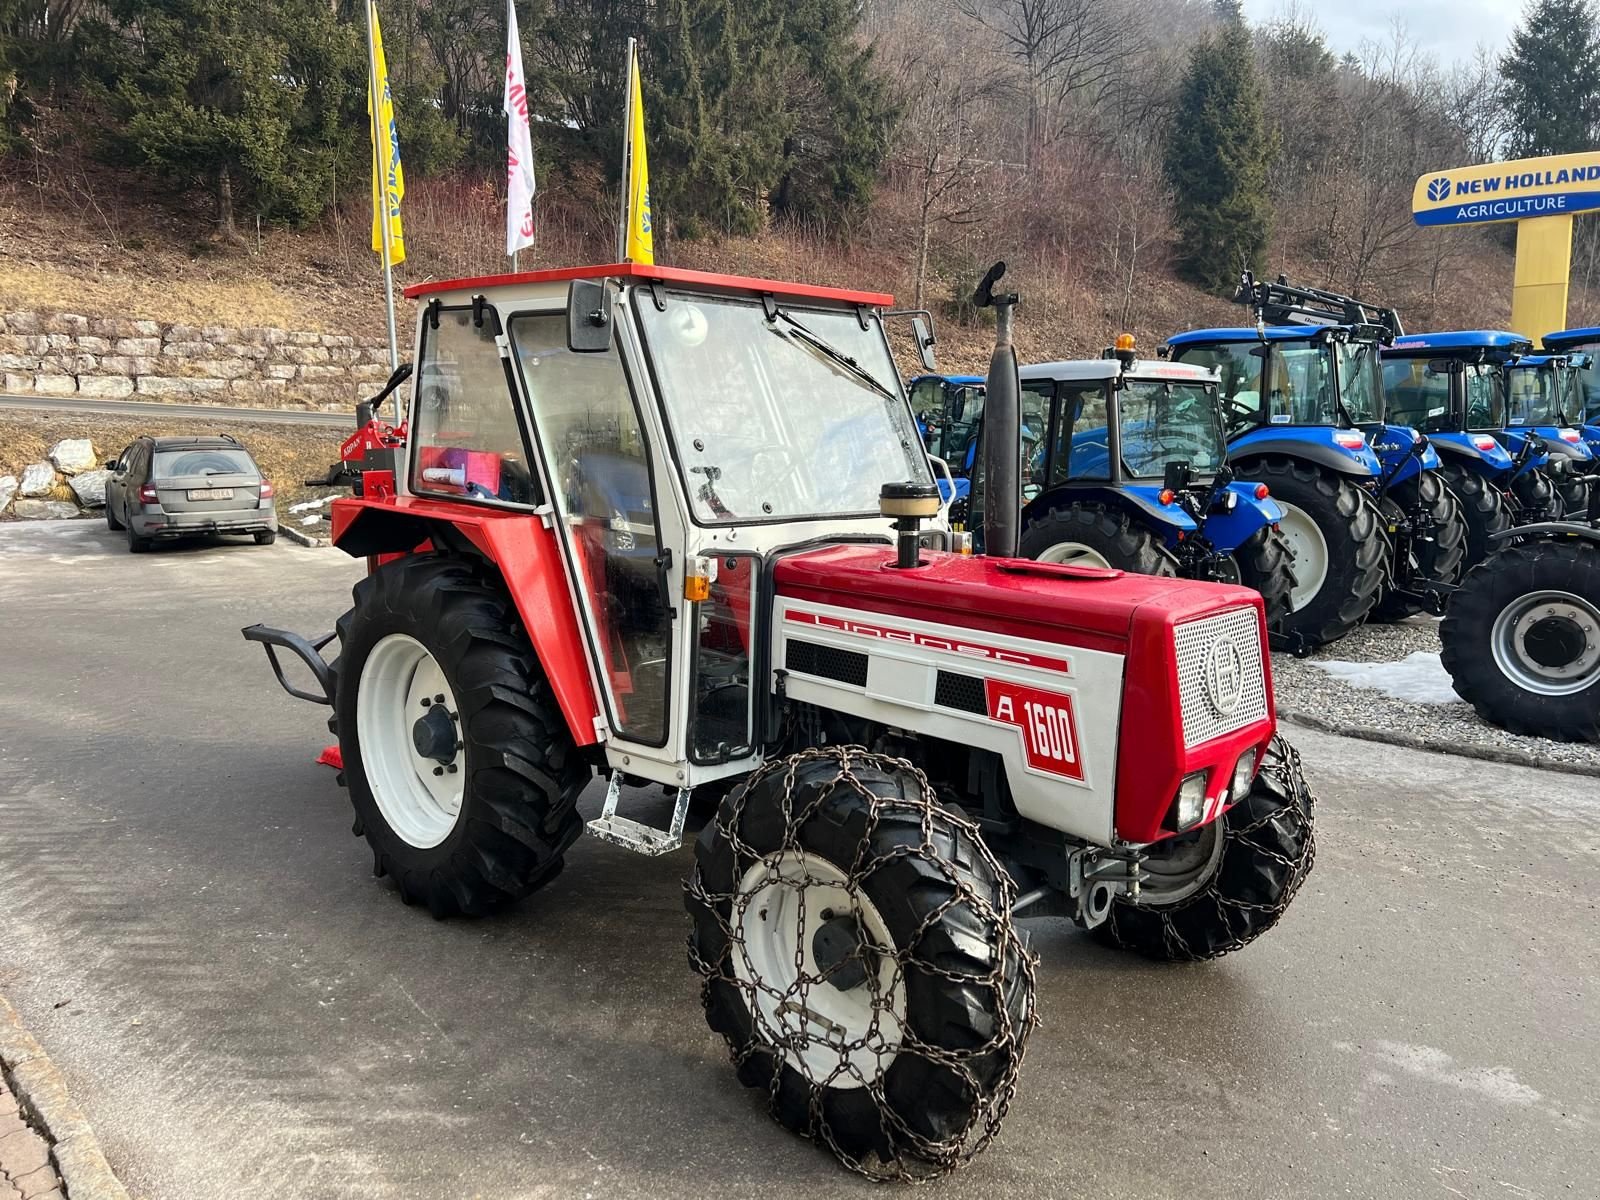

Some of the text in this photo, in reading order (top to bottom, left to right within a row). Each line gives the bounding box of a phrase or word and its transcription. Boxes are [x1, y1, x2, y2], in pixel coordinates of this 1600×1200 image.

[1456, 165, 1600, 195] NEW HOLLAND
[1456, 195, 1566, 219] AGRICULTURE
[996, 695, 1076, 764] A 1600
